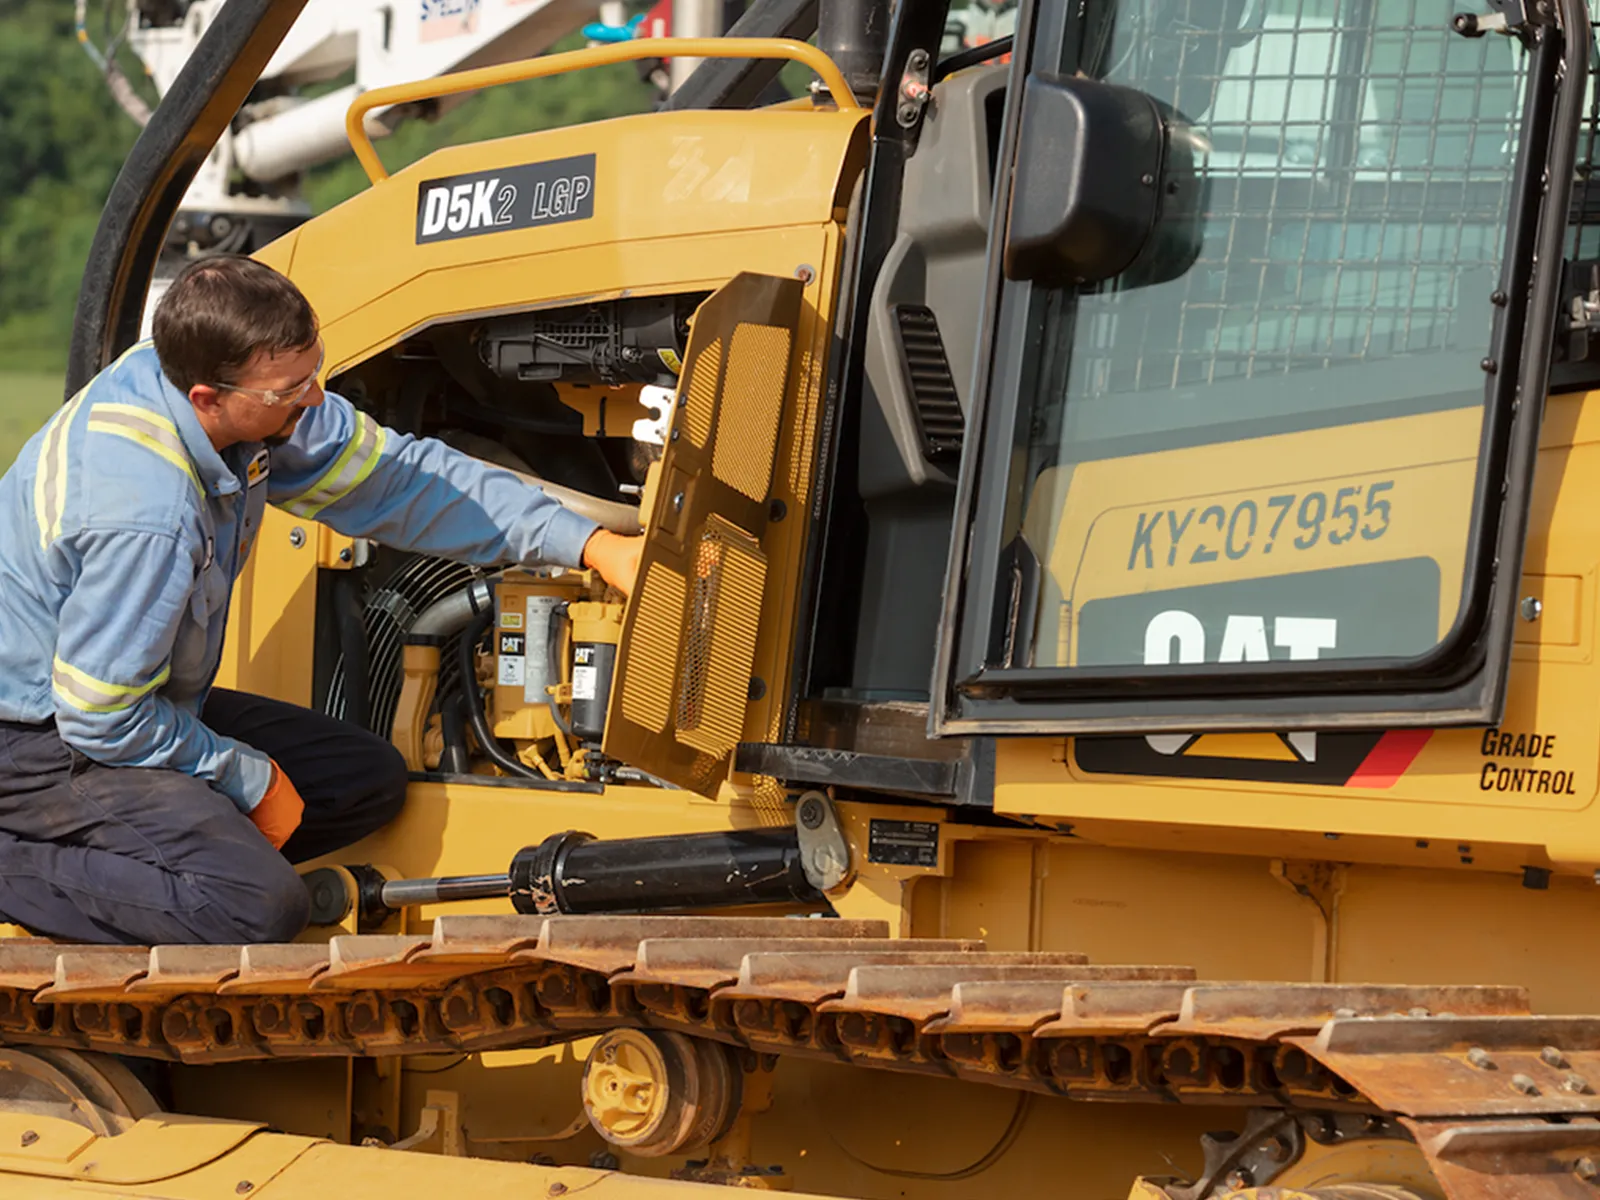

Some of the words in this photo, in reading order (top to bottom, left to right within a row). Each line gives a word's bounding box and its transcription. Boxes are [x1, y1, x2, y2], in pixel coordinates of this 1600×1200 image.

[422, 178, 517, 236] D5K2
[531, 175, 591, 220] LGP
[1127, 480, 1395, 571] KY207955
[1481, 727, 1556, 758] GRADE
[1480, 762, 1576, 795] CONTROL
